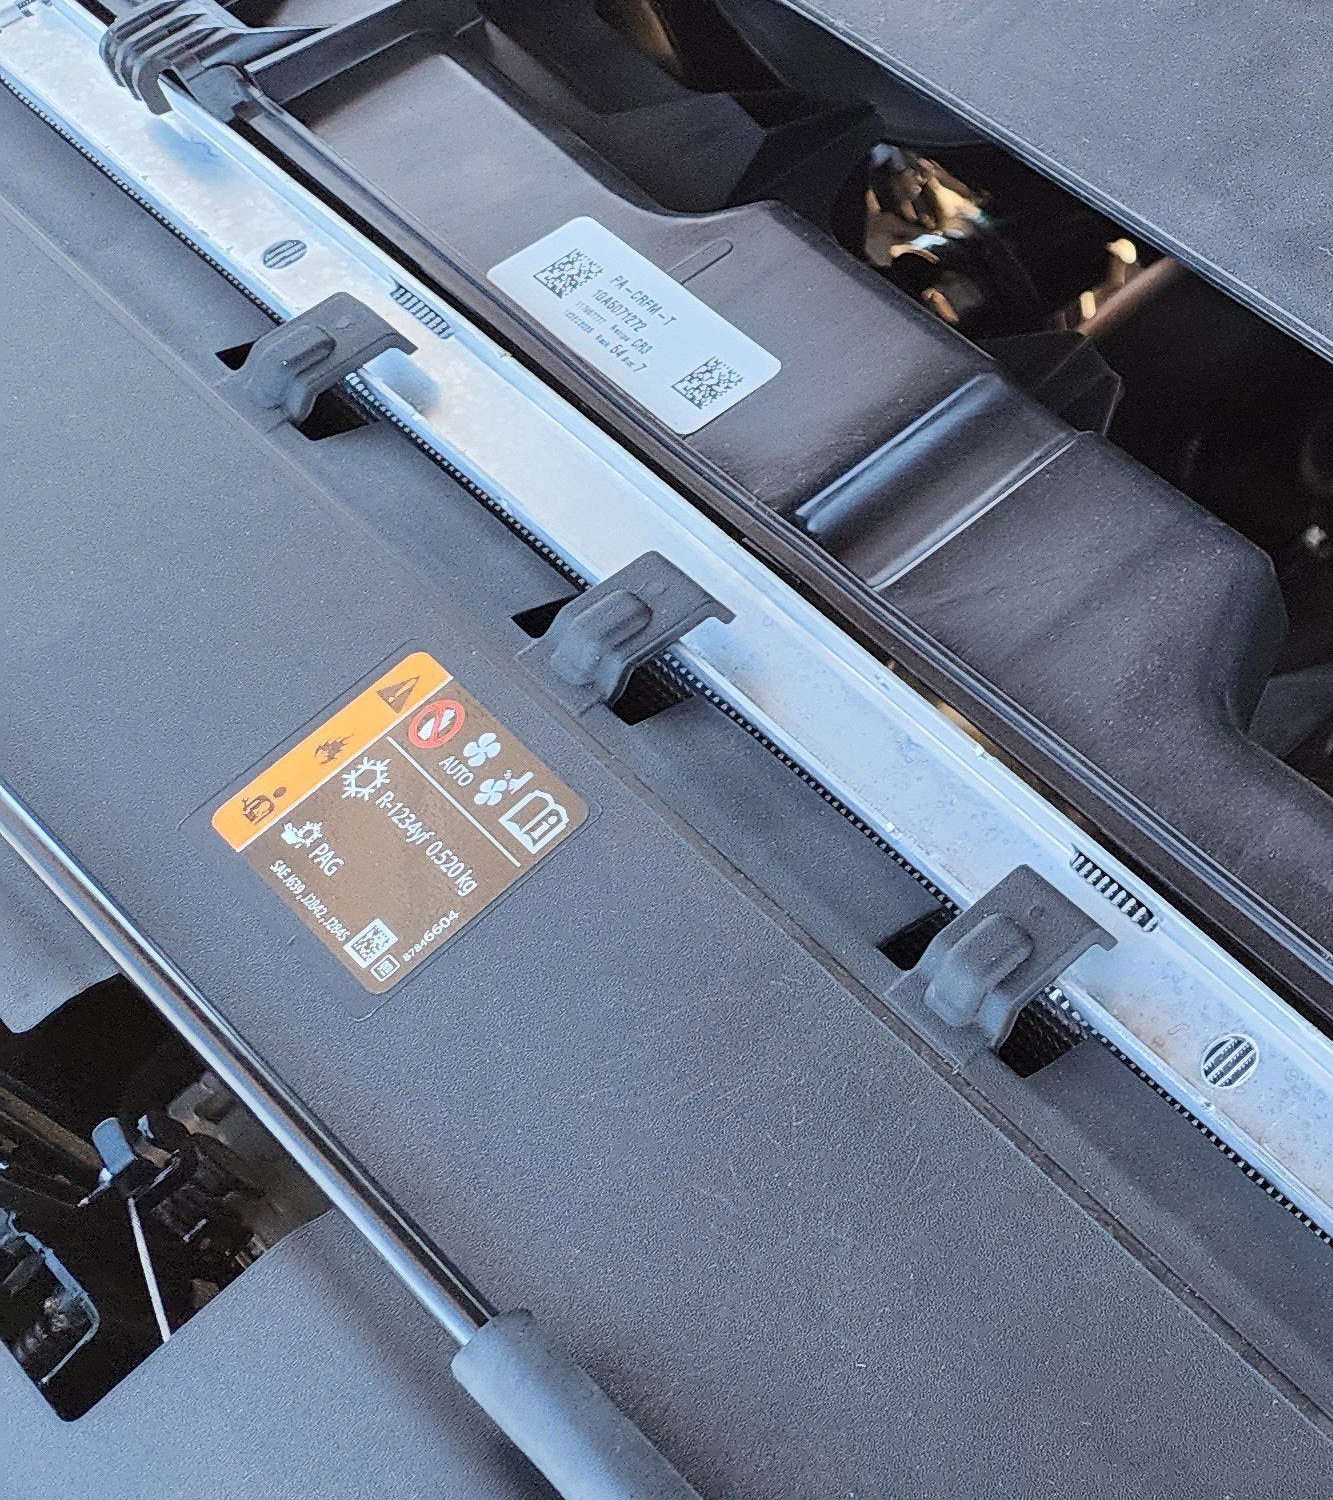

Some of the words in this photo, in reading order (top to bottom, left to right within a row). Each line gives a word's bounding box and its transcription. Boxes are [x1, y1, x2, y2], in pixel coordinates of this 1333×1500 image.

[610, 275, 677, 326] PA-CRFM-T
[438, 754, 475, 787] AUTO
[308, 845, 345, 877] PAG
[375, 791, 436, 847] R-1234yf
[426, 840, 467, 879] 0.520
[452, 872, 479, 898] kg
[270, 858, 292, 880] SAE
